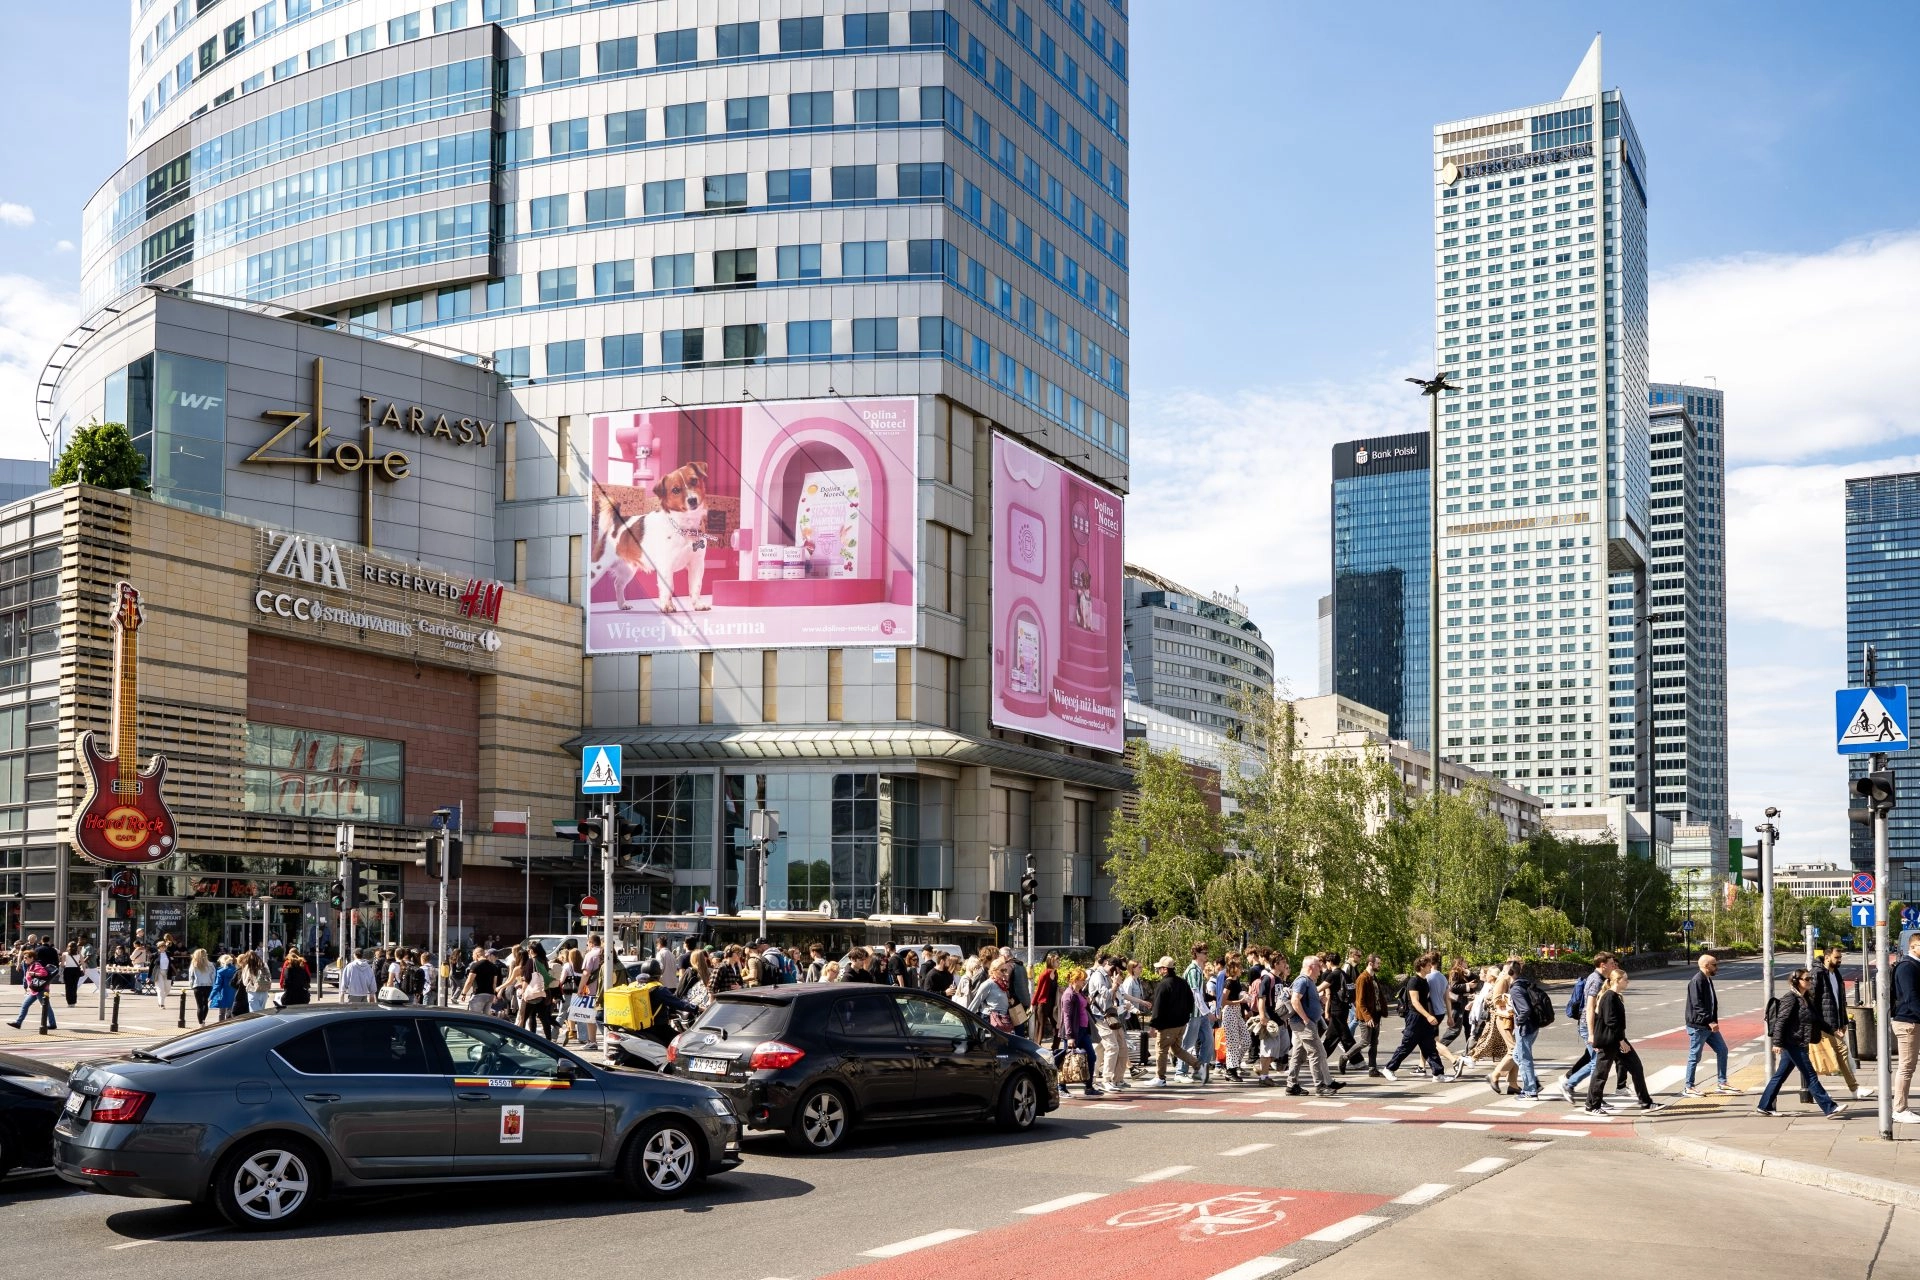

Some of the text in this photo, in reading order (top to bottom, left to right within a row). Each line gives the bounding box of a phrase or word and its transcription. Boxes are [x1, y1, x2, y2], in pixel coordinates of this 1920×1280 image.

[360, 394, 495, 448] TARASY
[863, 410, 897, 420] Dolina
[870, 419, 906, 429] Noteci
[1371, 449, 1392, 459] Bank
[1394, 445, 1418, 457] Polski
[1094, 497, 1114, 518] Dolina
[1098, 511, 1119, 532] Noteci
[266, 530, 504, 625] ZARA RESERVED H&M
[1212, 589, 1249, 619] accenture
[255, 589, 478, 644] CCC STRADIVARIUS Carrefour
[606, 618, 766, 643] Więcej niż karma
[1053, 688, 1116, 719] Więcej niż karma
[85, 813, 164, 834] Hard Rock
[116, 834, 137, 842] CAFE
[591, 884, 648, 895] SKLIGHT
[768, 899, 814, 910] COSTA
[489, 1079, 512, 1087] 25507
